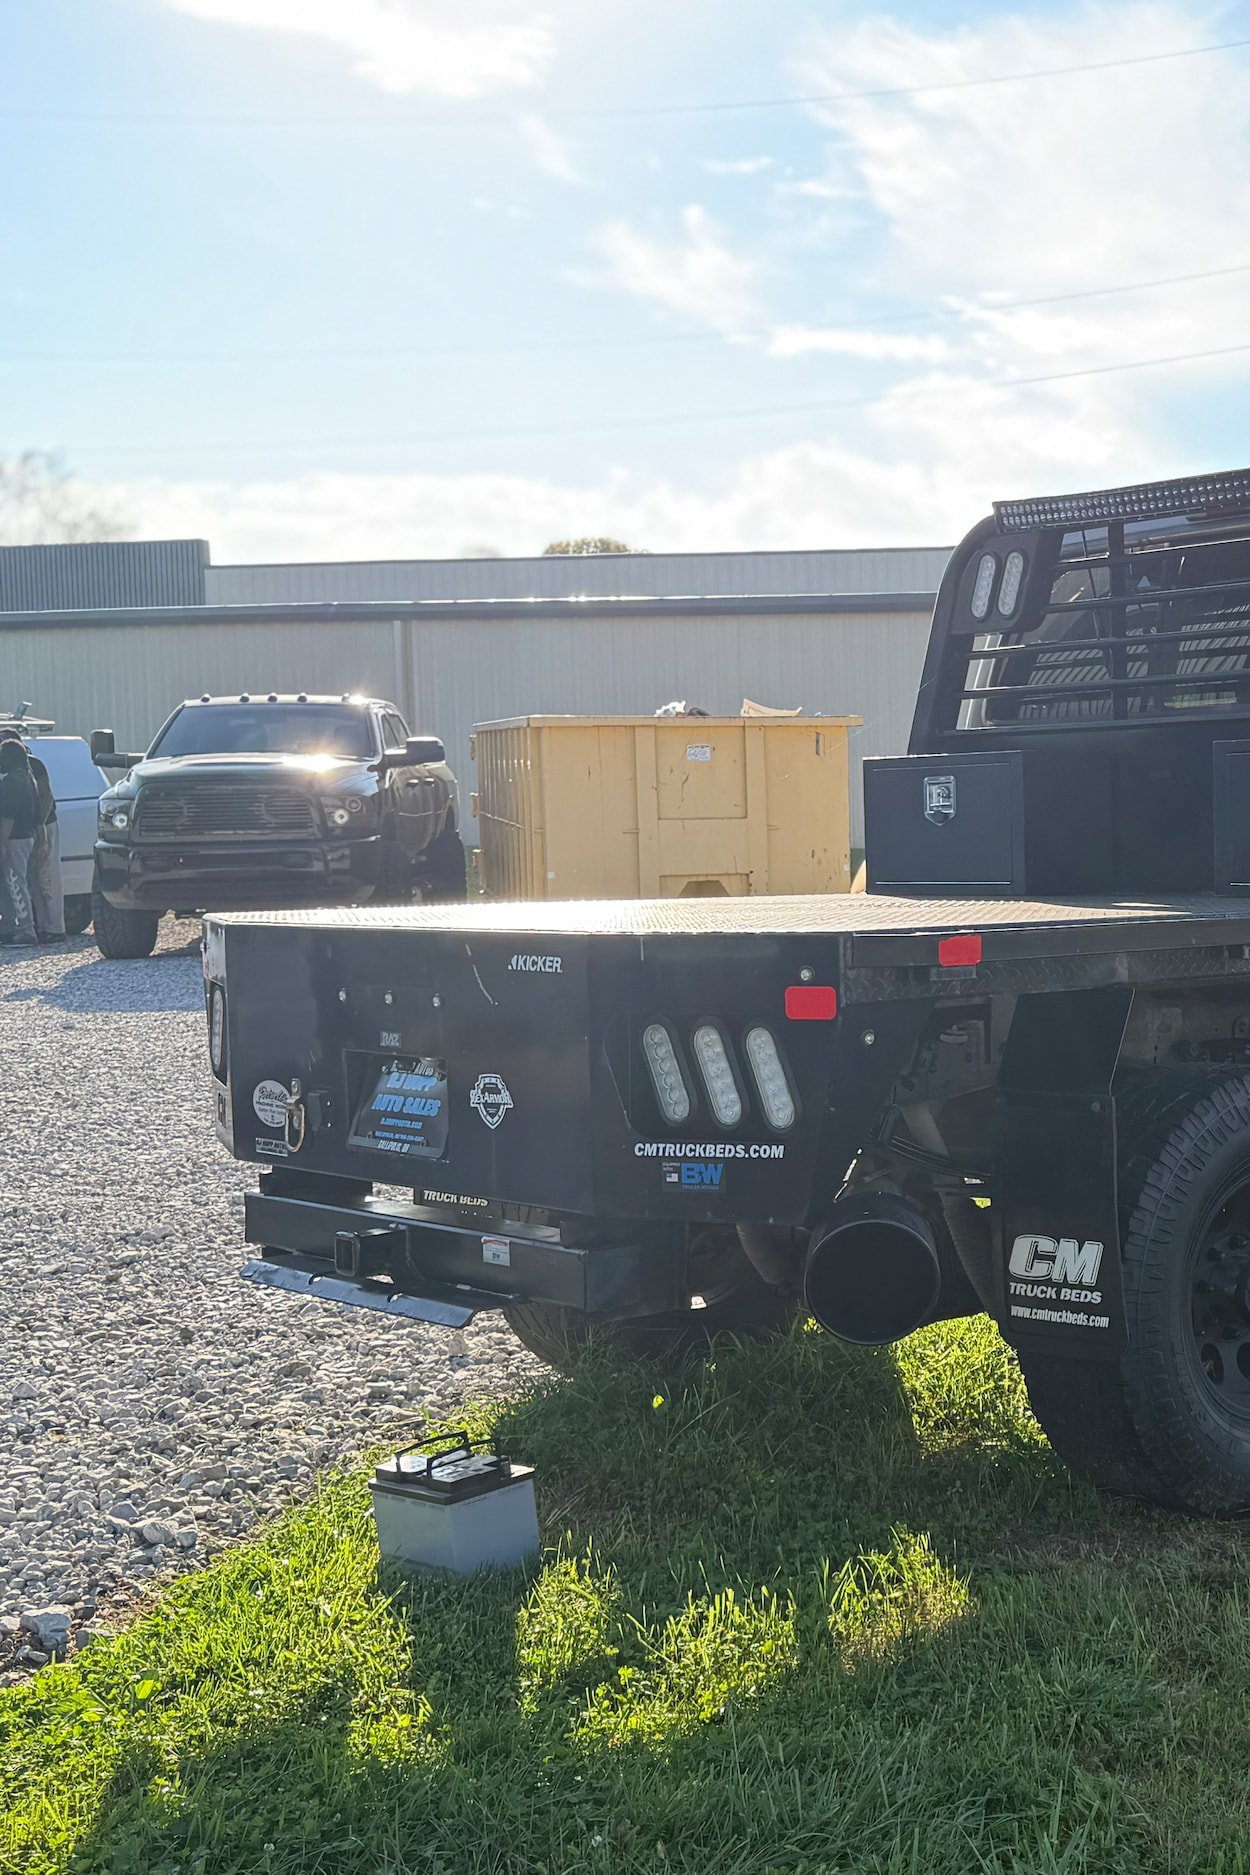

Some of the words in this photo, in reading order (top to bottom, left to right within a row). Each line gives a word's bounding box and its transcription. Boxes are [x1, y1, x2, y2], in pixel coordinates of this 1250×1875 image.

[517, 955, 562, 973] KICKER
[372, 1094, 404, 1112] AUTO
[402, 1096, 441, 1117] SALES
[634, 1142, 785, 1159] CMTRUCKBEDS.COM
[423, 1189, 458, 1203] TRUCK
[1008, 1233, 1105, 1287] CM
[1009, 1282, 1058, 1300] TRUCK
[1060, 1288, 1103, 1305] BEDS
[1011, 1305, 1109, 1328] www.cmtruckbeds.com
